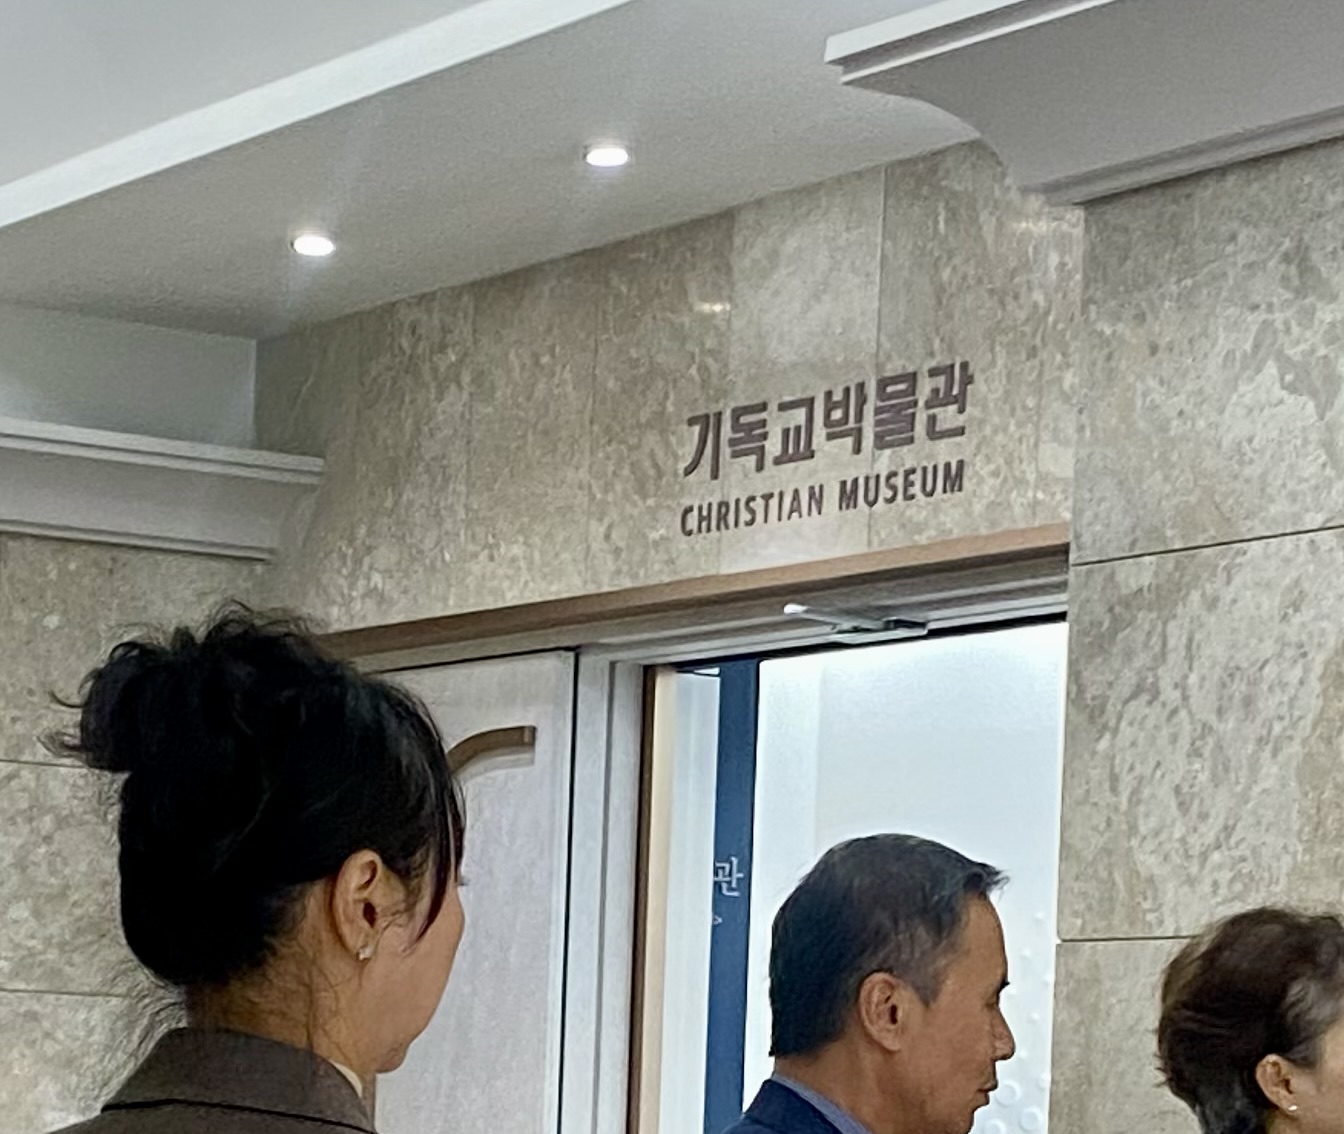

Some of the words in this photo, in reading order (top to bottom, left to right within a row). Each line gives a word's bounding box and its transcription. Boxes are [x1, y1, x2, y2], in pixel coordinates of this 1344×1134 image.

[683, 361, 974, 480] 기독교박물관
[680, 483, 824, 537] CHRISTIAN
[838, 459, 965, 511] MUSEUM
